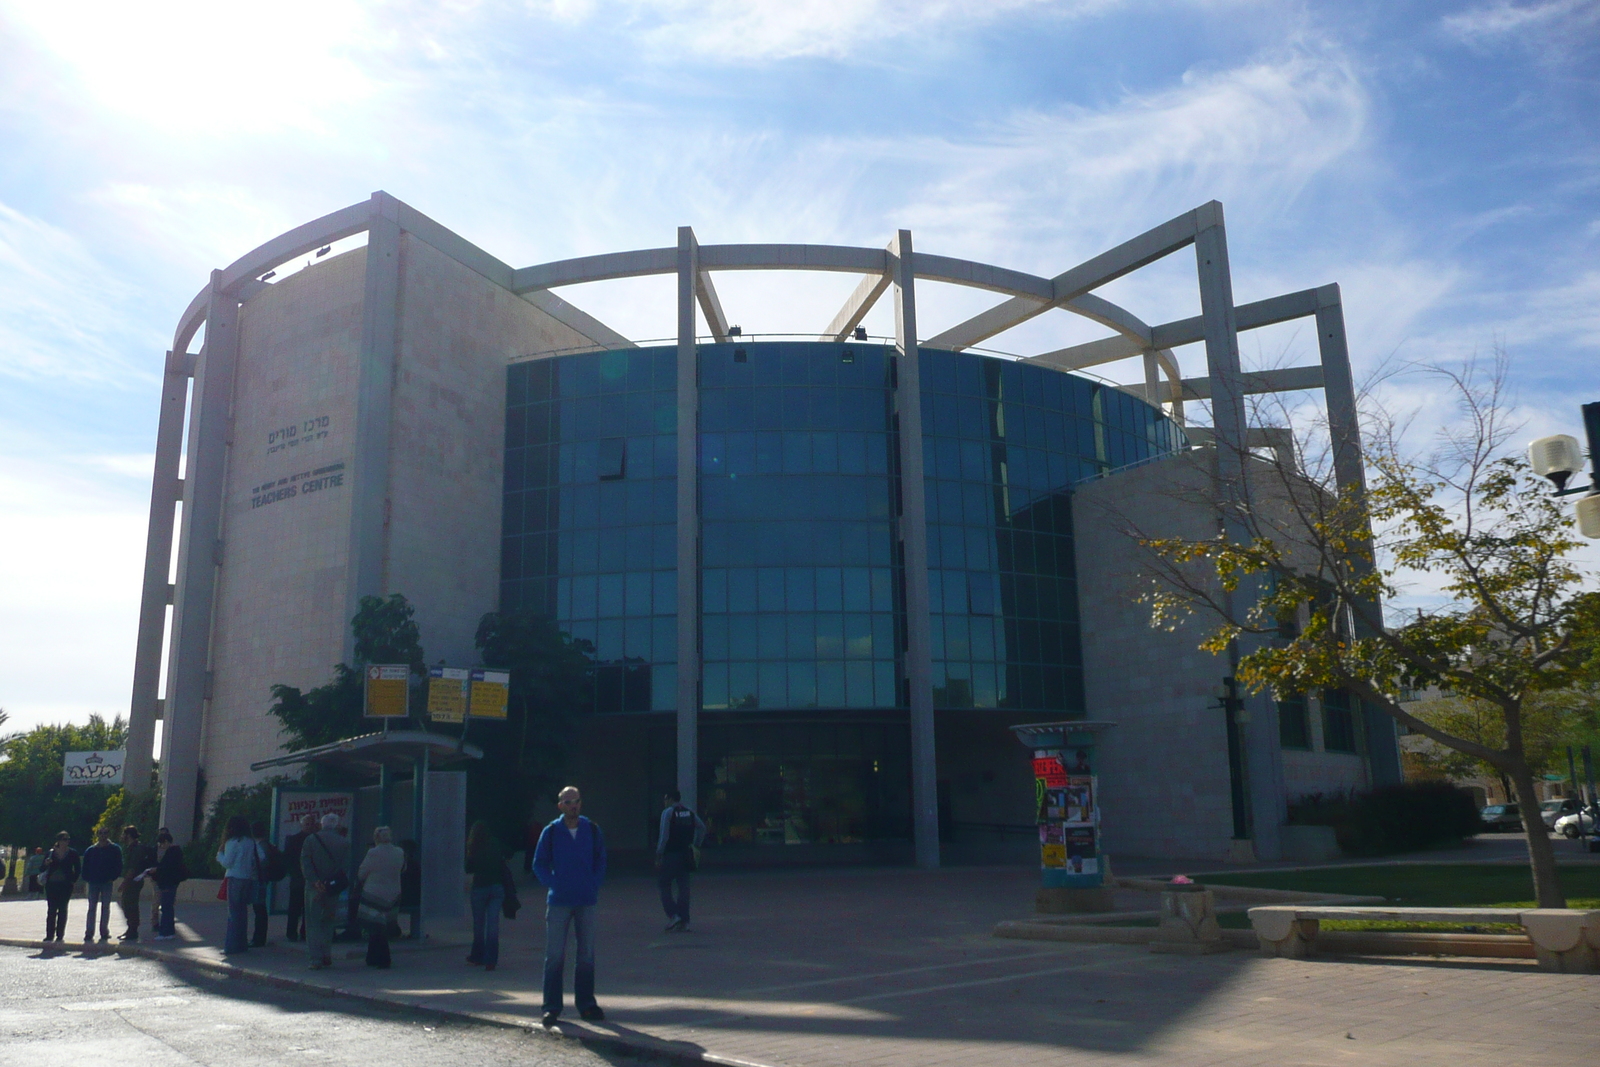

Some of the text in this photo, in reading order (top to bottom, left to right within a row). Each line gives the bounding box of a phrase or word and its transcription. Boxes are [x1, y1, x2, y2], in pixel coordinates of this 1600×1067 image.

[303, 415, 330, 432] מרכז
[268, 425, 297, 445] מורים
[252, 485, 297, 509] TEACHERS
[302, 473, 344, 494] CENTRE
[288, 800, 317, 813] קניות
